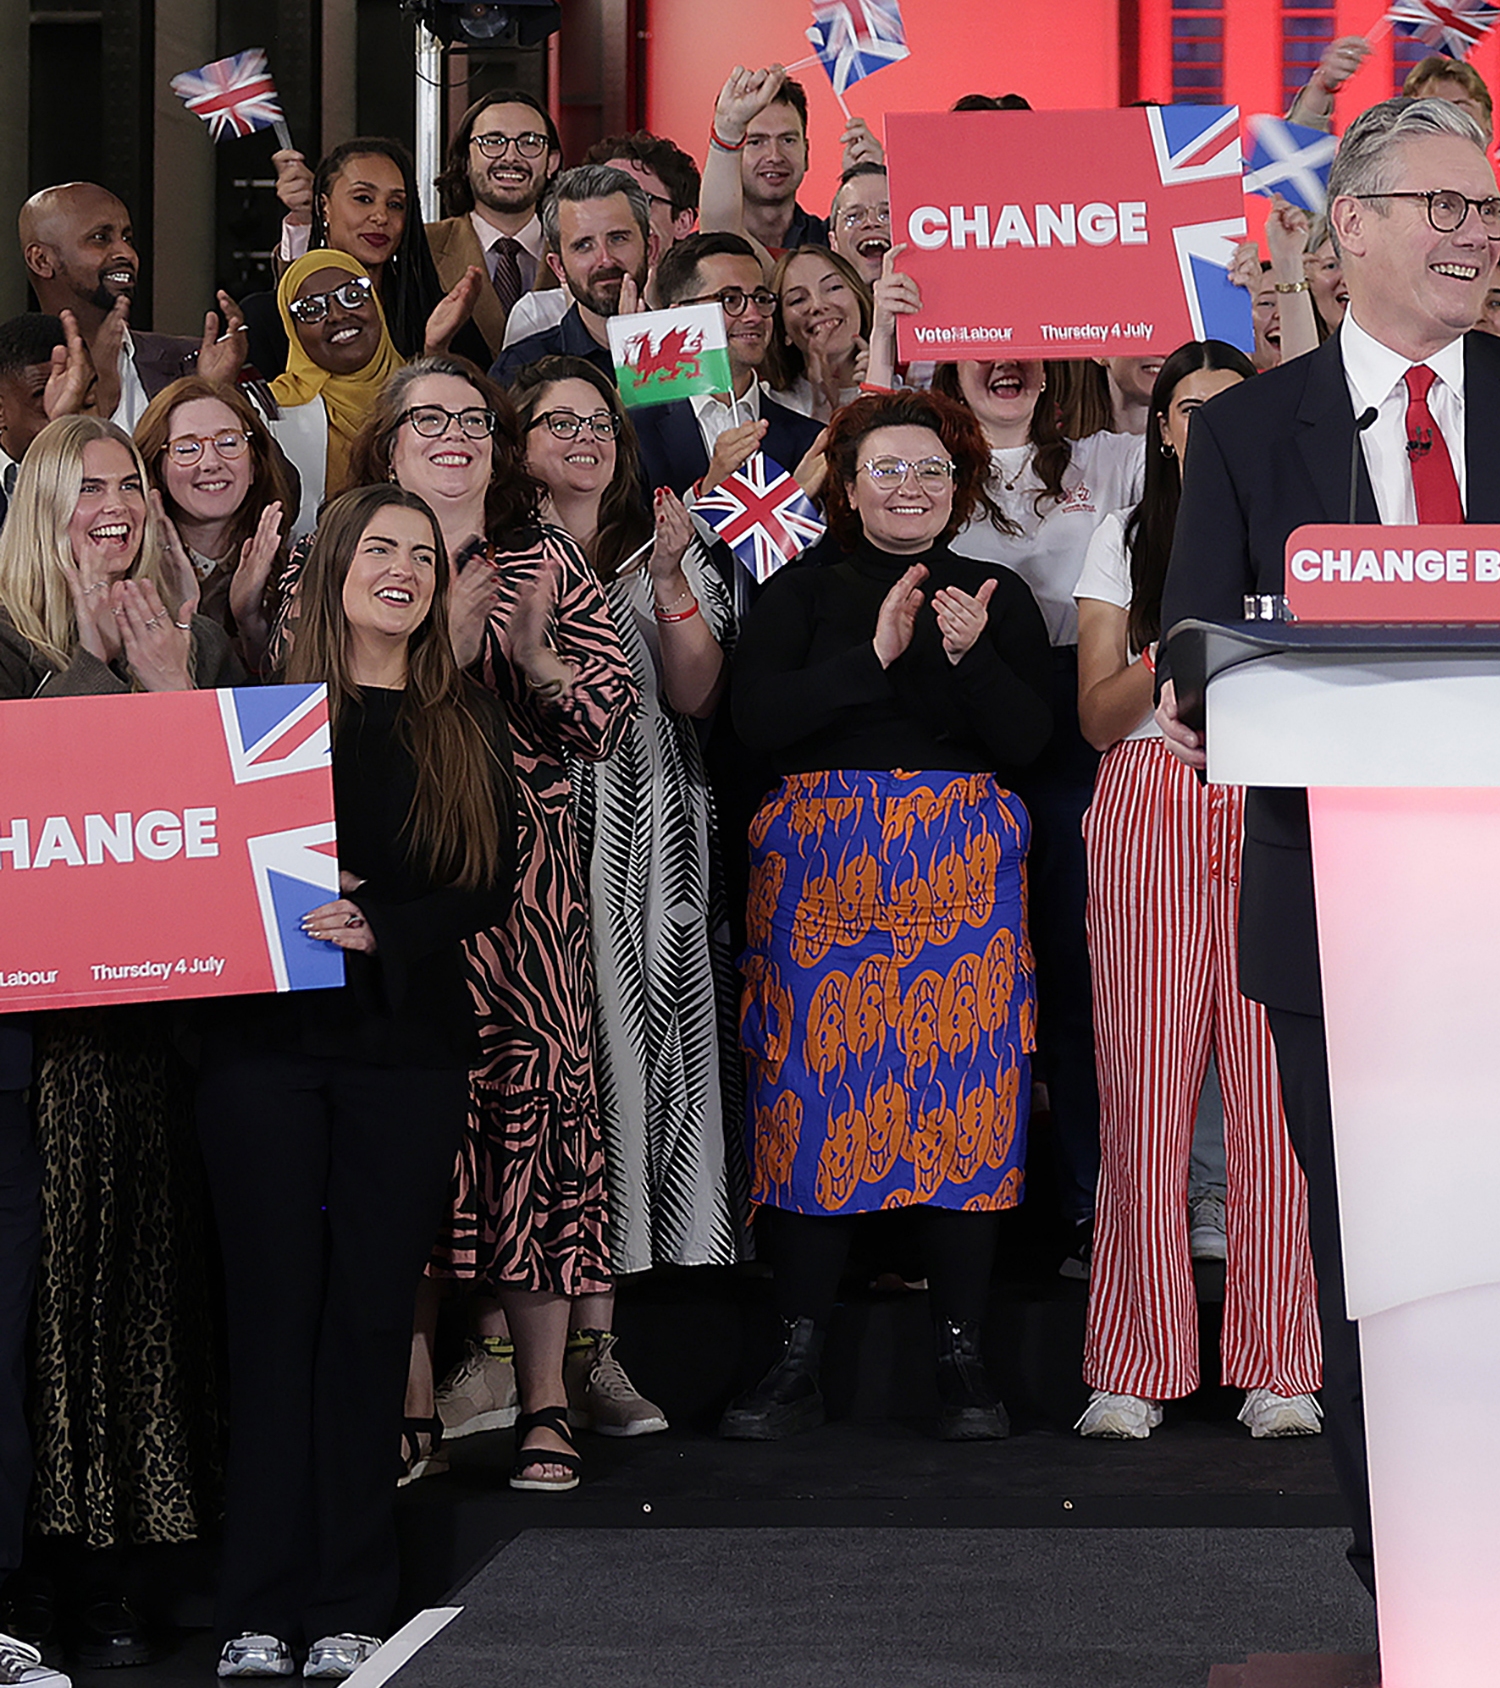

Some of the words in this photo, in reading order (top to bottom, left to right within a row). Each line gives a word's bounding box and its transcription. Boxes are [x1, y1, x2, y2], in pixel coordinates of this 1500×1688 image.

[908, 201, 1149, 250] CHANGE
[914, 326, 951, 343] Vote
[964, 326, 1013, 342] Labour
[1040, 322, 1108, 342] Thursday
[1111, 323, 1121, 337] 4
[1123, 322, 1153, 340] July
[1291, 549, 1468, 582] CHANGE
[0, 969, 58, 987] Labour
[91, 960, 172, 981] Thursday
[174, 958, 187, 974] 4
[189, 956, 225, 976] July
